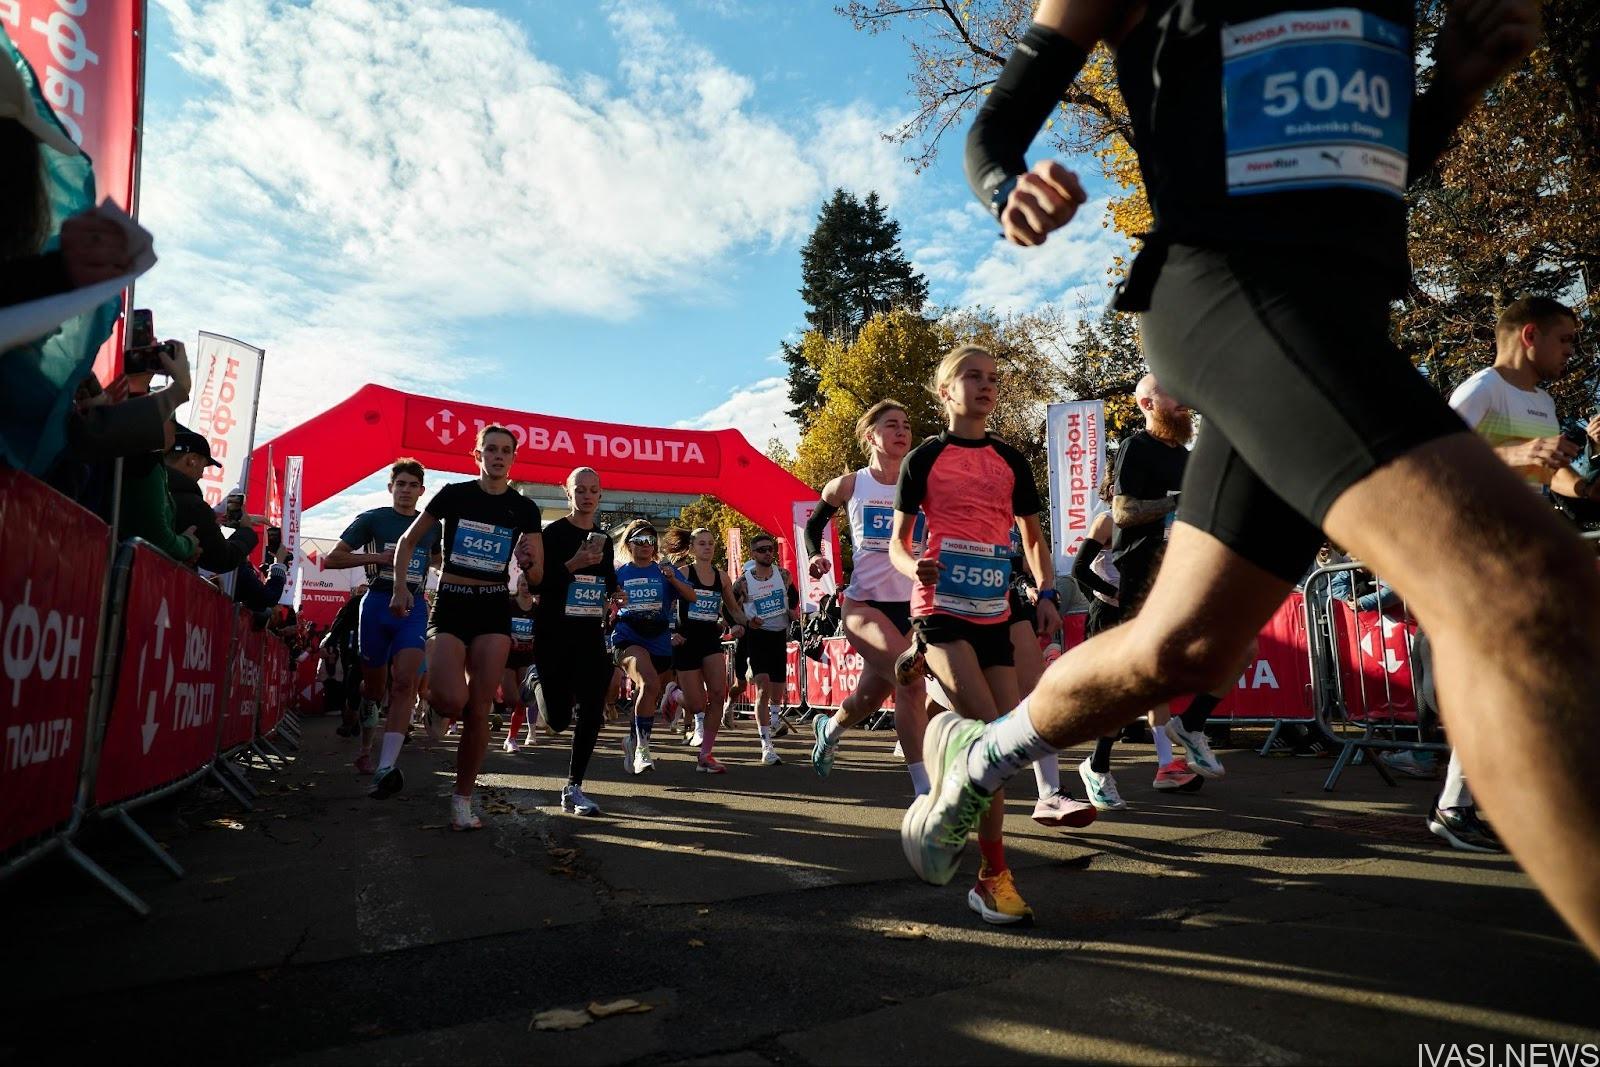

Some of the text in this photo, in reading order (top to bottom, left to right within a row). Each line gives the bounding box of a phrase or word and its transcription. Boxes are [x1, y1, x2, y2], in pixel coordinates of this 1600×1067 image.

[1241, 18, 1350, 45] НОВА ПОШТА
[1263, 67, 1391, 119] 5040
[583, 433, 706, 464] ПОШТА
[1087, 413, 1098, 490] НОВА ПОШТА
[1065, 413, 1089, 531] Марафон
[873, 515, 893, 529] 57
[463, 536, 501, 554] 5451
[948, 542, 967, 551] НОВА
[969, 544, 992, 553] ПОШТА
[302, 580, 334, 588] NewRun
[951, 564, 1004, 588] 5598
[442, 583, 507, 594] PUMA PUMA
[575, 589, 601, 600] 5434
[630, 588, 657, 598] 5036
[314, 594, 346, 602] ПОШТА
[696, 600, 717, 609] 5074
[837, 653, 864, 671] НОВ
[4, 718, 72, 772] ПОШТА
